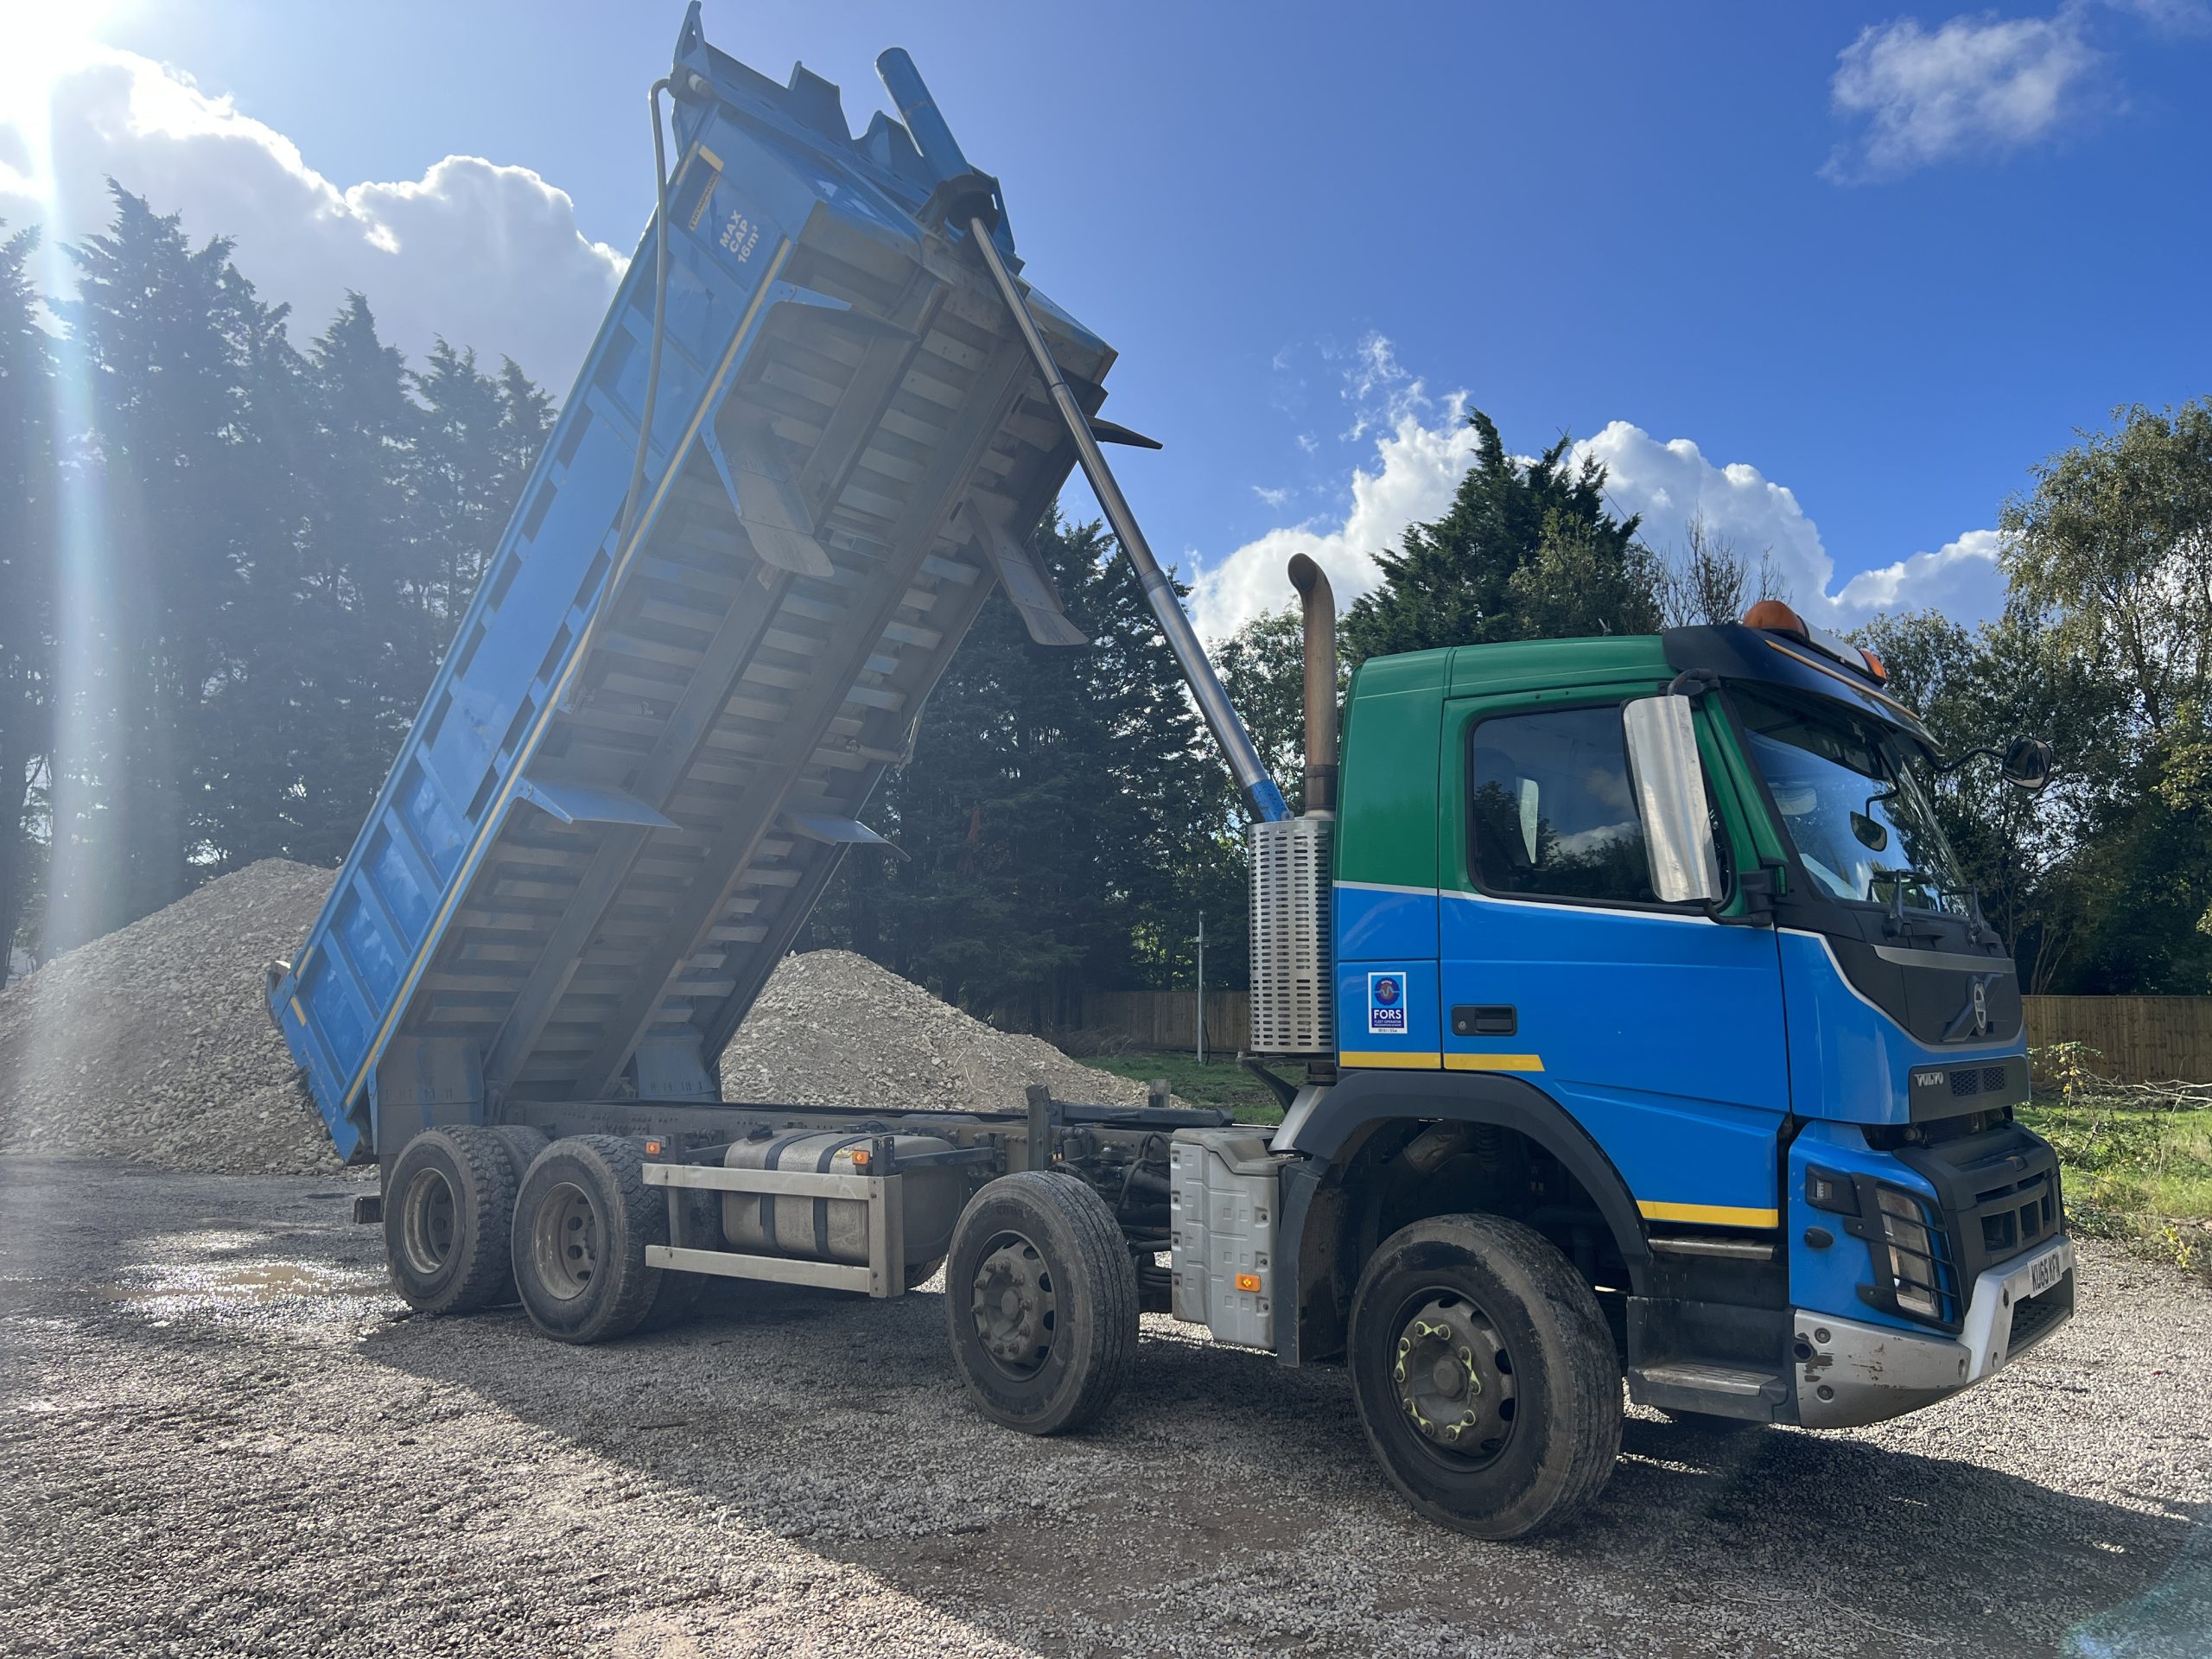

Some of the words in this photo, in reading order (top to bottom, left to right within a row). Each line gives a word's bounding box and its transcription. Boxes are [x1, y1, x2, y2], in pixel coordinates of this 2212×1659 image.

[719, 209, 742, 248] MAX
[729, 219, 748, 253] CAP
[1374, 1009, 1402, 1020] FORS
[1915, 1071, 1944, 1087] VOLVO
[2031, 1258, 2049, 1292] KU65
